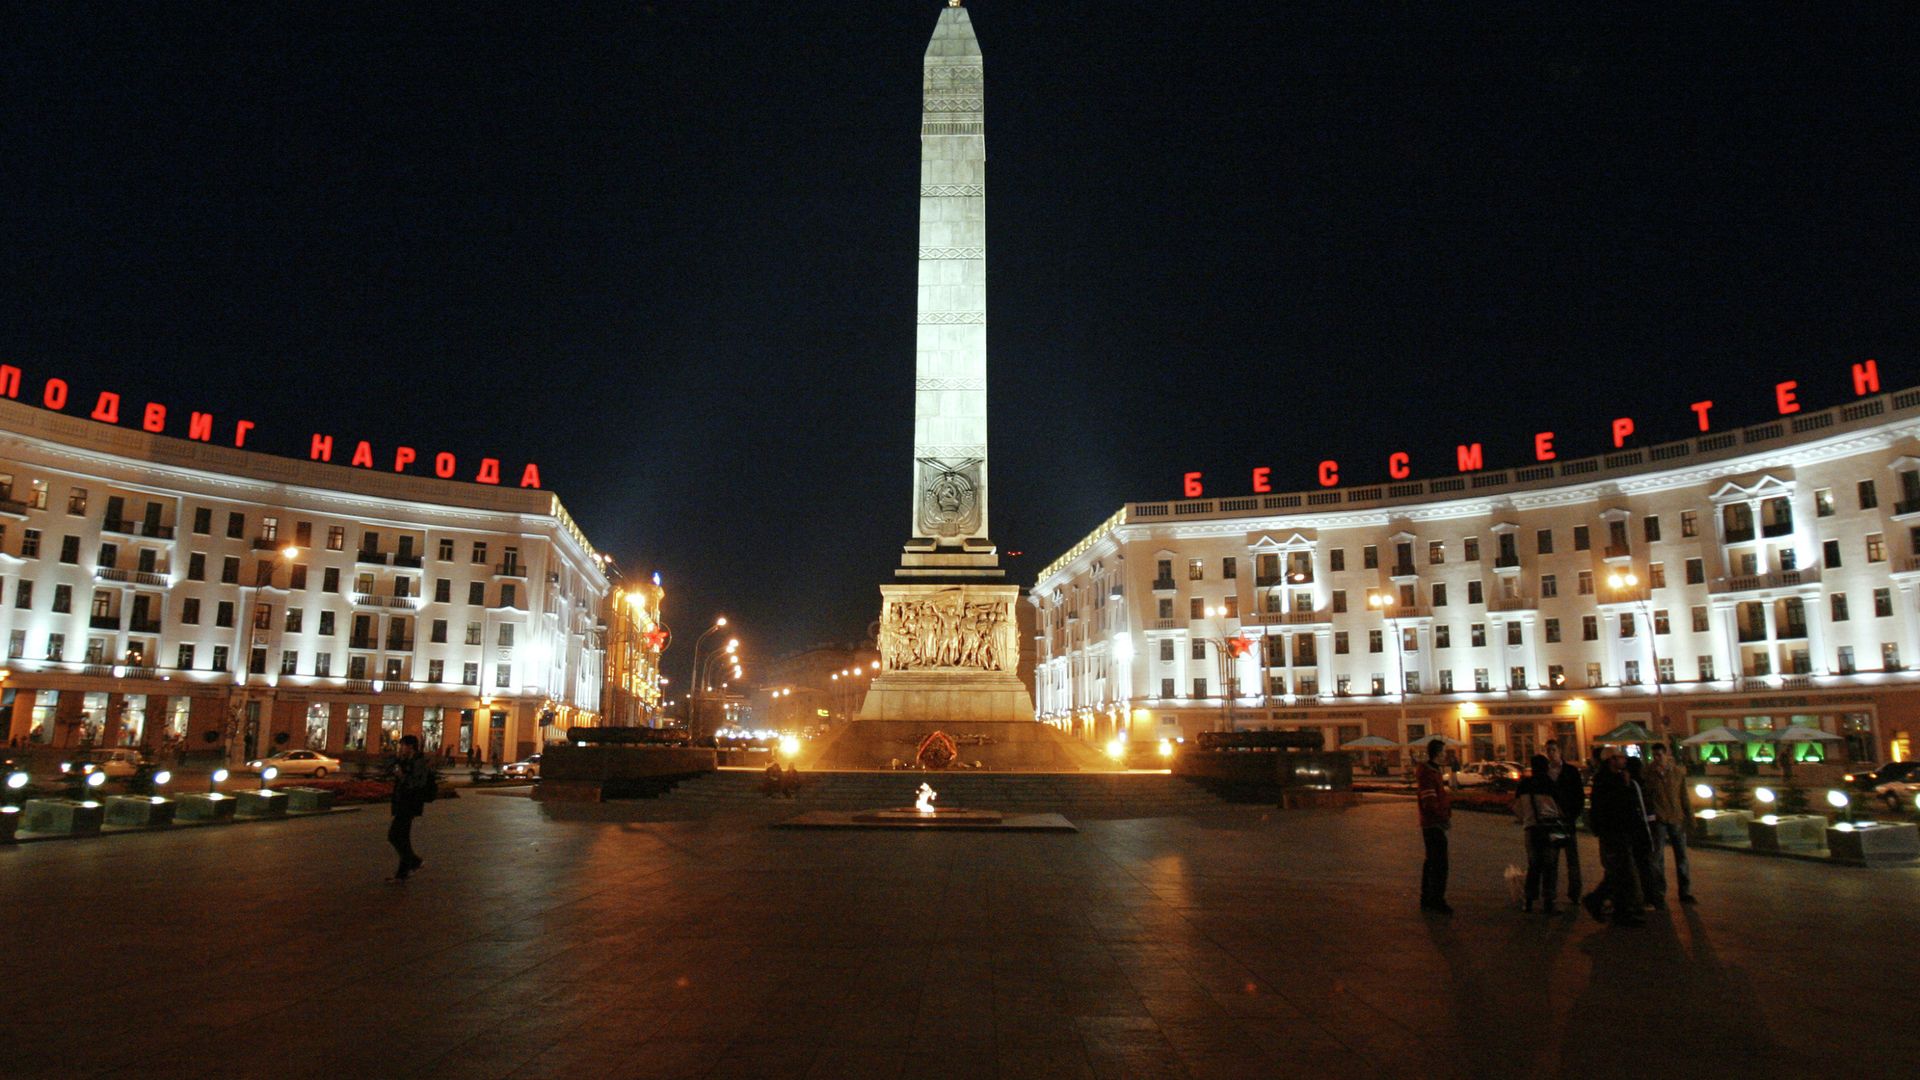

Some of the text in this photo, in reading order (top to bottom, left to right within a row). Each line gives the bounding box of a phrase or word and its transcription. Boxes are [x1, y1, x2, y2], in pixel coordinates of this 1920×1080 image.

[0, 364, 541, 489] ПОДВИГ НАРОДА
[1184, 360, 1880, 497] БЕССМЕРТЕН
